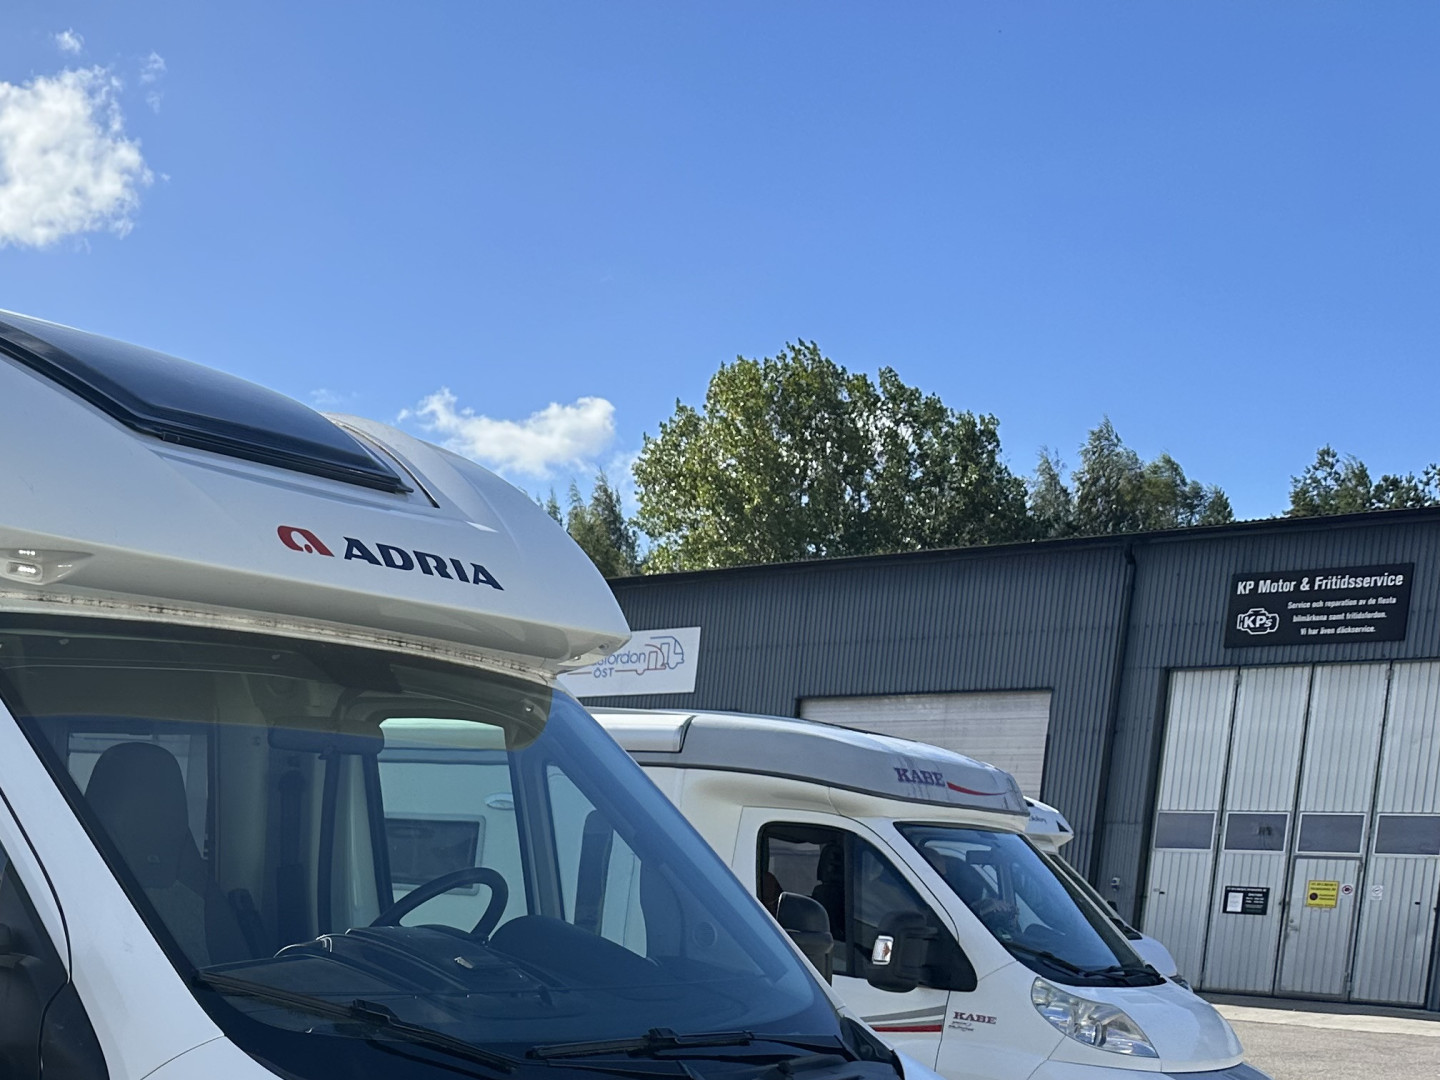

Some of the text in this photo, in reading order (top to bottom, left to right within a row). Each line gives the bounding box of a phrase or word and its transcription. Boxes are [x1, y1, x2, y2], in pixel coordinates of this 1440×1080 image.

[343, 536, 505, 591] ADRIA
[1237, 572, 1404, 595] KP Motor & Fritidsservice
[1287, 601, 1311, 609] Service
[1243, 615, 1273, 628] KPs
[893, 767, 946, 787] KABE
[952, 1011, 998, 1025] KABE
